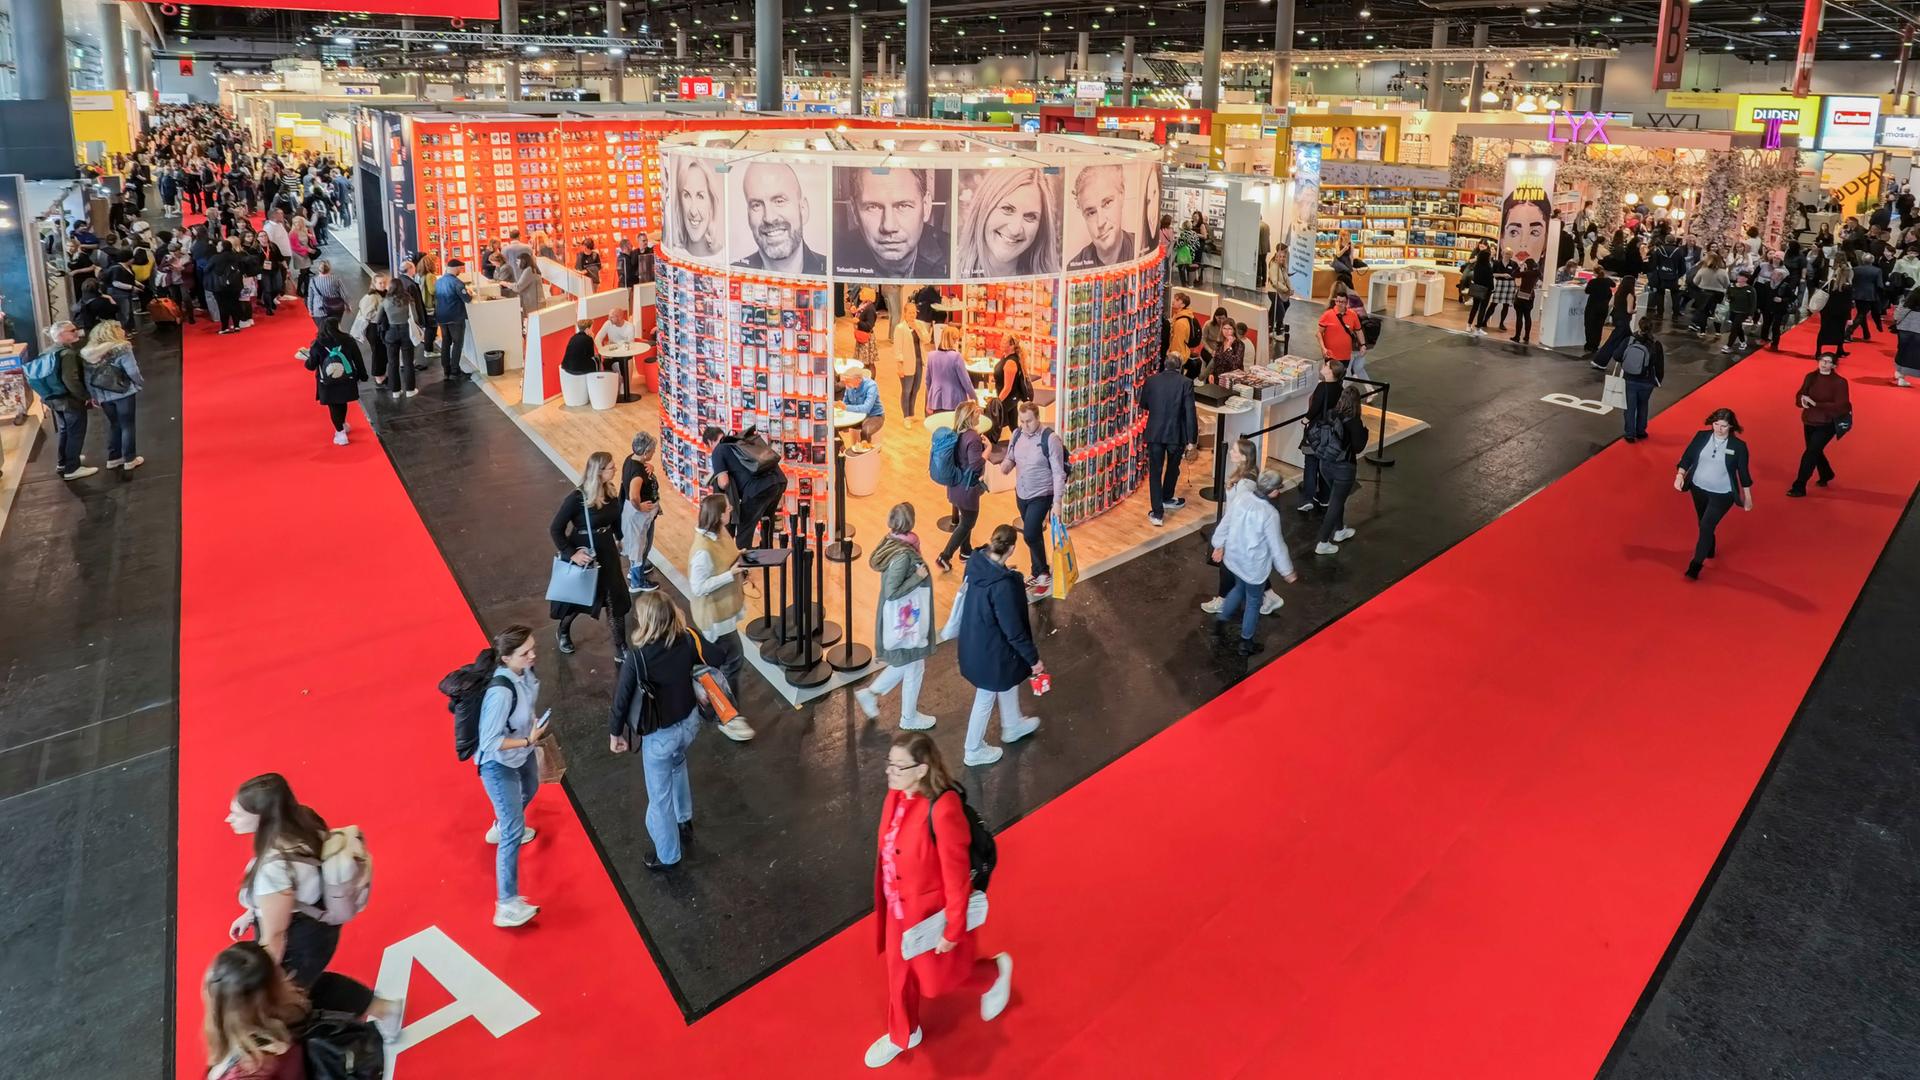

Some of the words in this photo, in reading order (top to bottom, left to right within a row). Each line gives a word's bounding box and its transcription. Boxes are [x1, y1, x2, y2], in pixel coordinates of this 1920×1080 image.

[1753, 109, 1799, 121] DUDEN
[1548, 110, 1613, 145] LYX
[1512, 188, 1545, 201] MANN
[374, 925, 542, 1080] A
